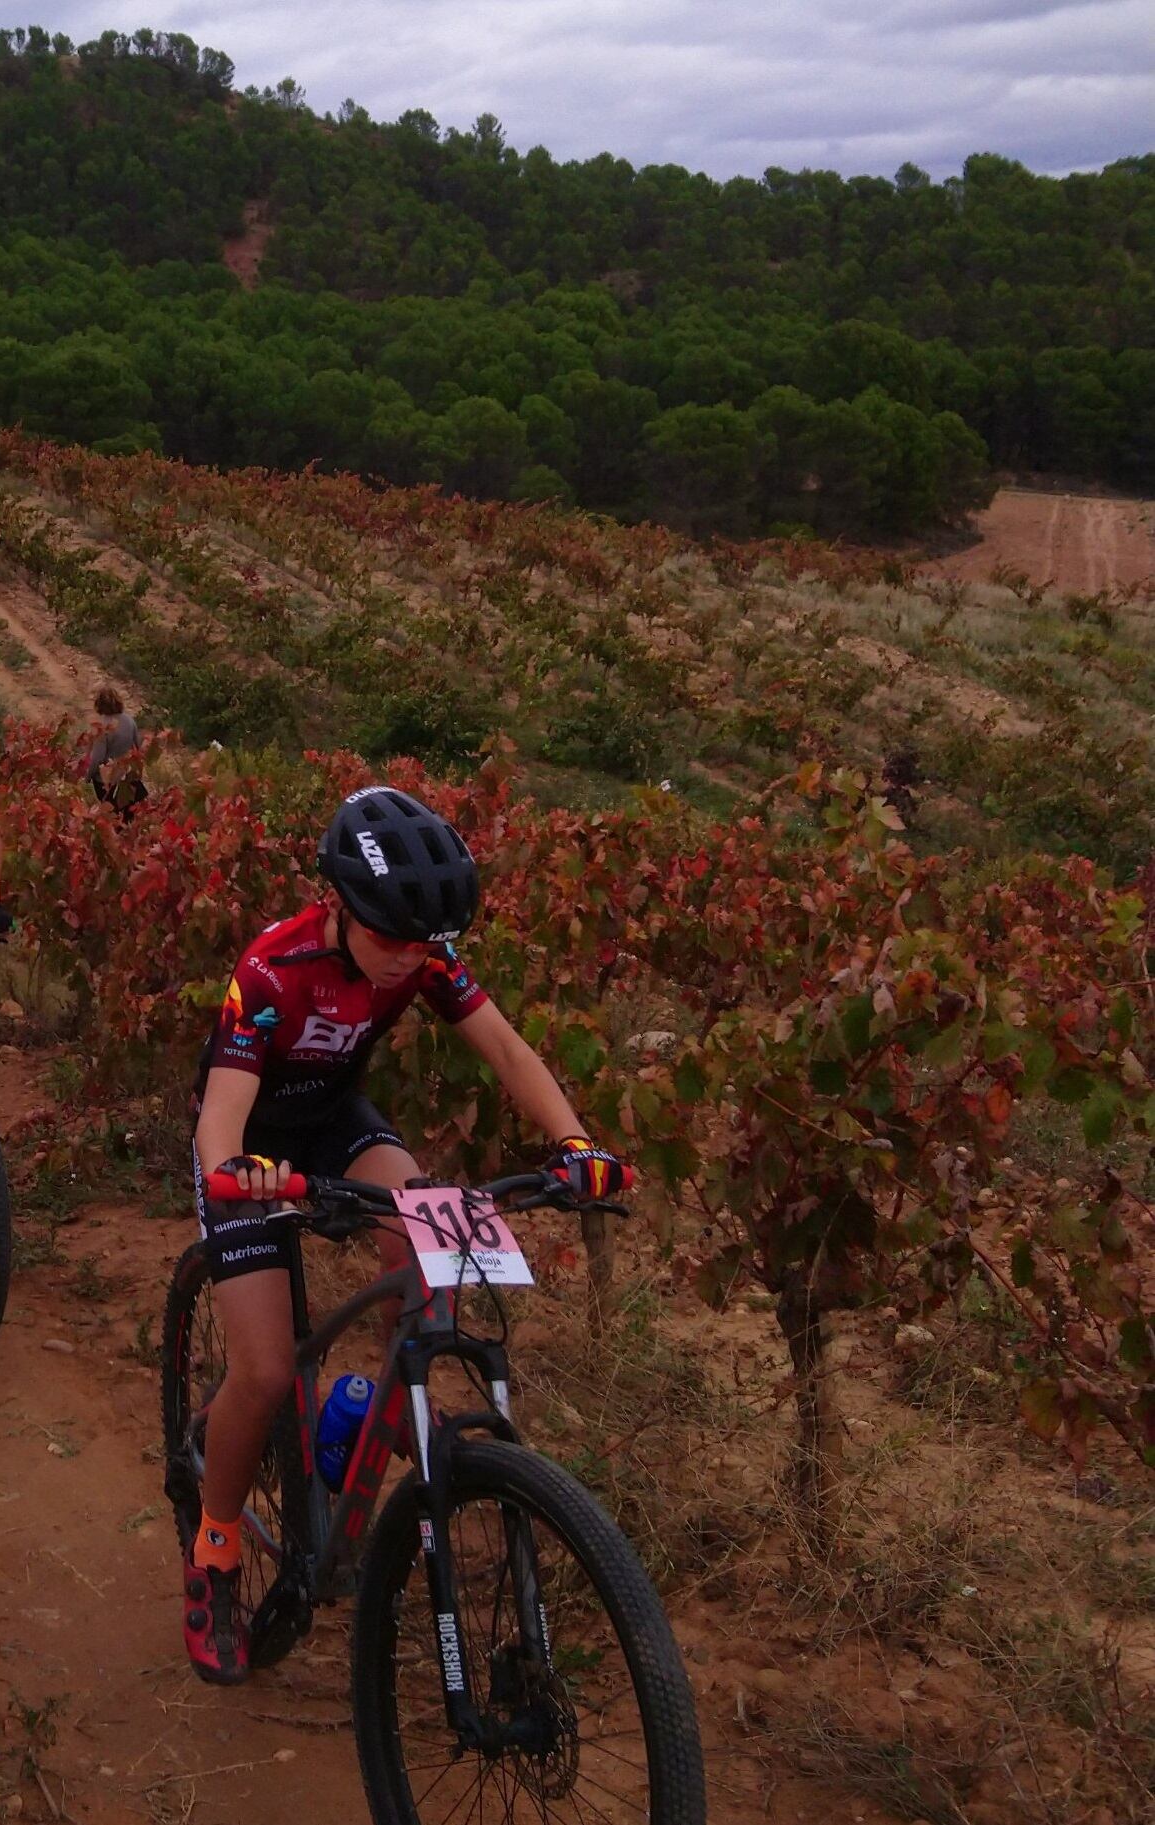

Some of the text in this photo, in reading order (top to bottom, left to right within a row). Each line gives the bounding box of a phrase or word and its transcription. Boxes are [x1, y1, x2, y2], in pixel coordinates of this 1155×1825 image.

[356, 831, 390, 878] LAZER
[415, 1197, 502, 1249] 116
[436, 1612, 466, 1694] ROCKSHOX
